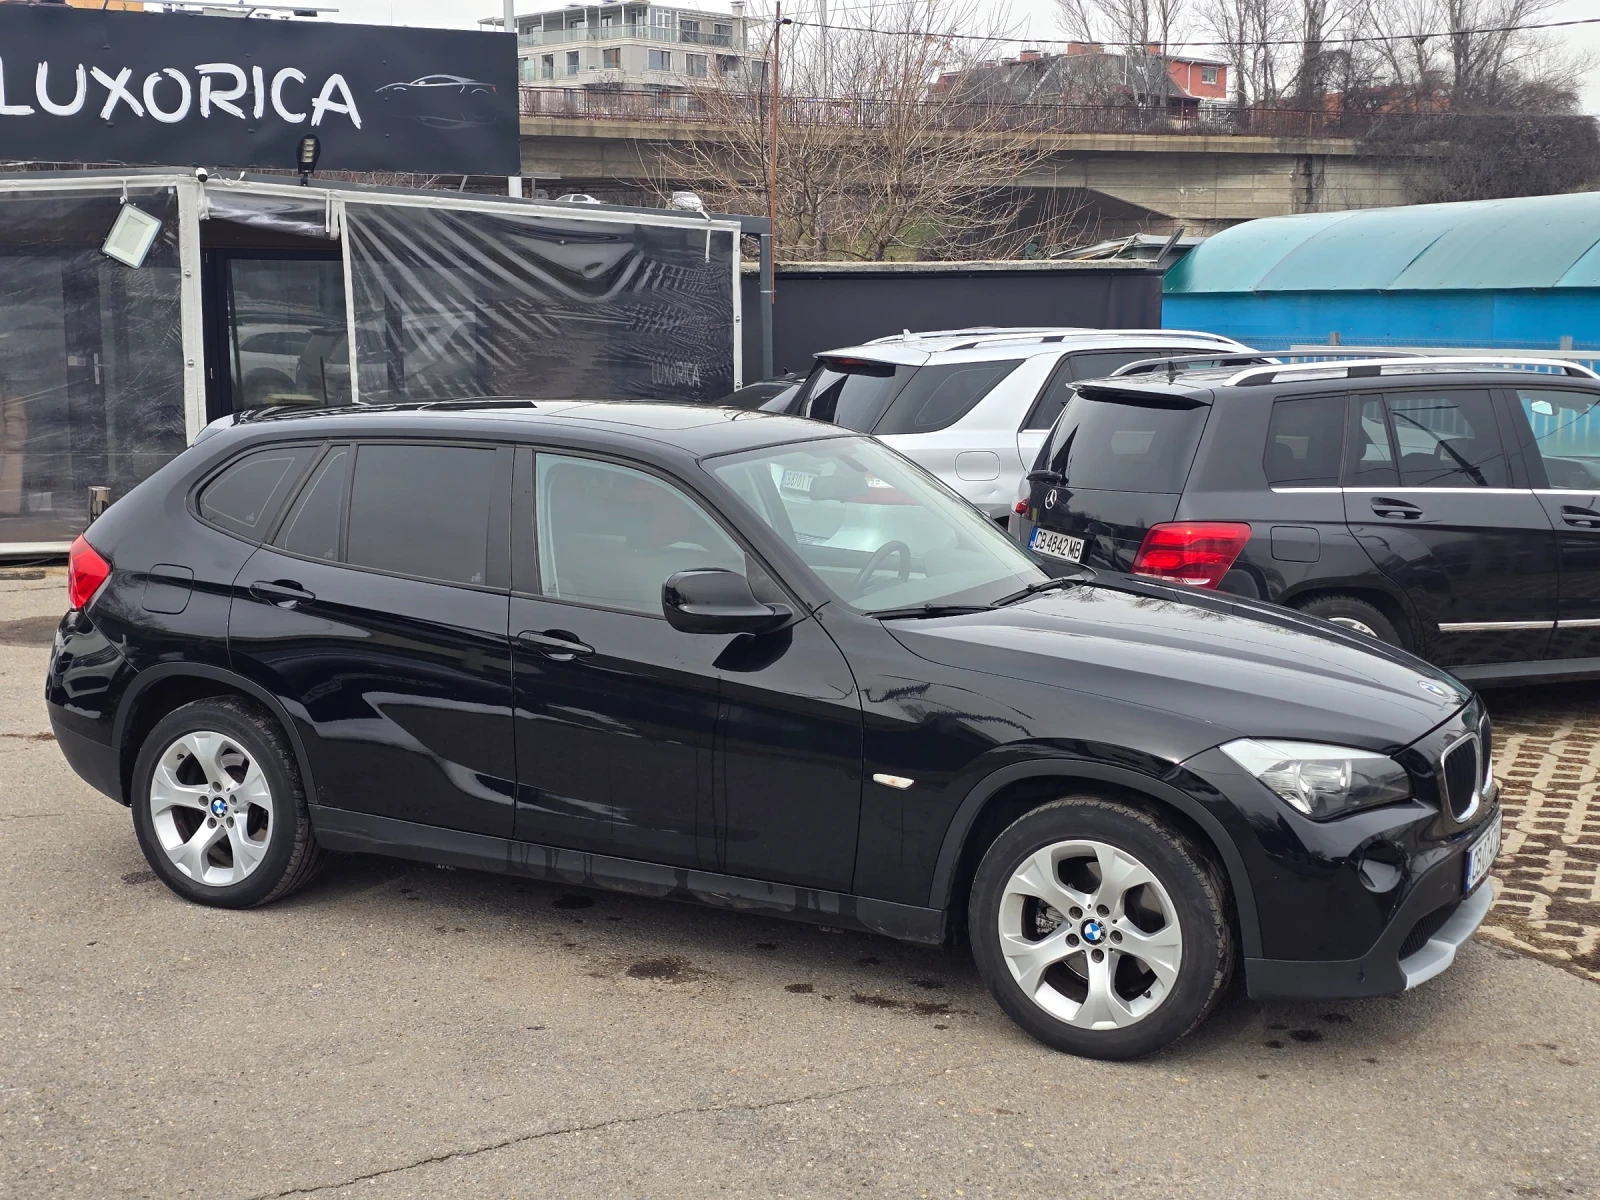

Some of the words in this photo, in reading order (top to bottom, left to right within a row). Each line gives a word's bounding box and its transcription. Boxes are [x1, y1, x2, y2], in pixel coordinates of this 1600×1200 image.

[0, 56, 362, 130] LUXORICA
[651, 361, 701, 387] LUXORICA
[1035, 531, 1047, 549] CB
[1046, 534, 1069, 556] 4842
[1067, 540, 1081, 559] MB
